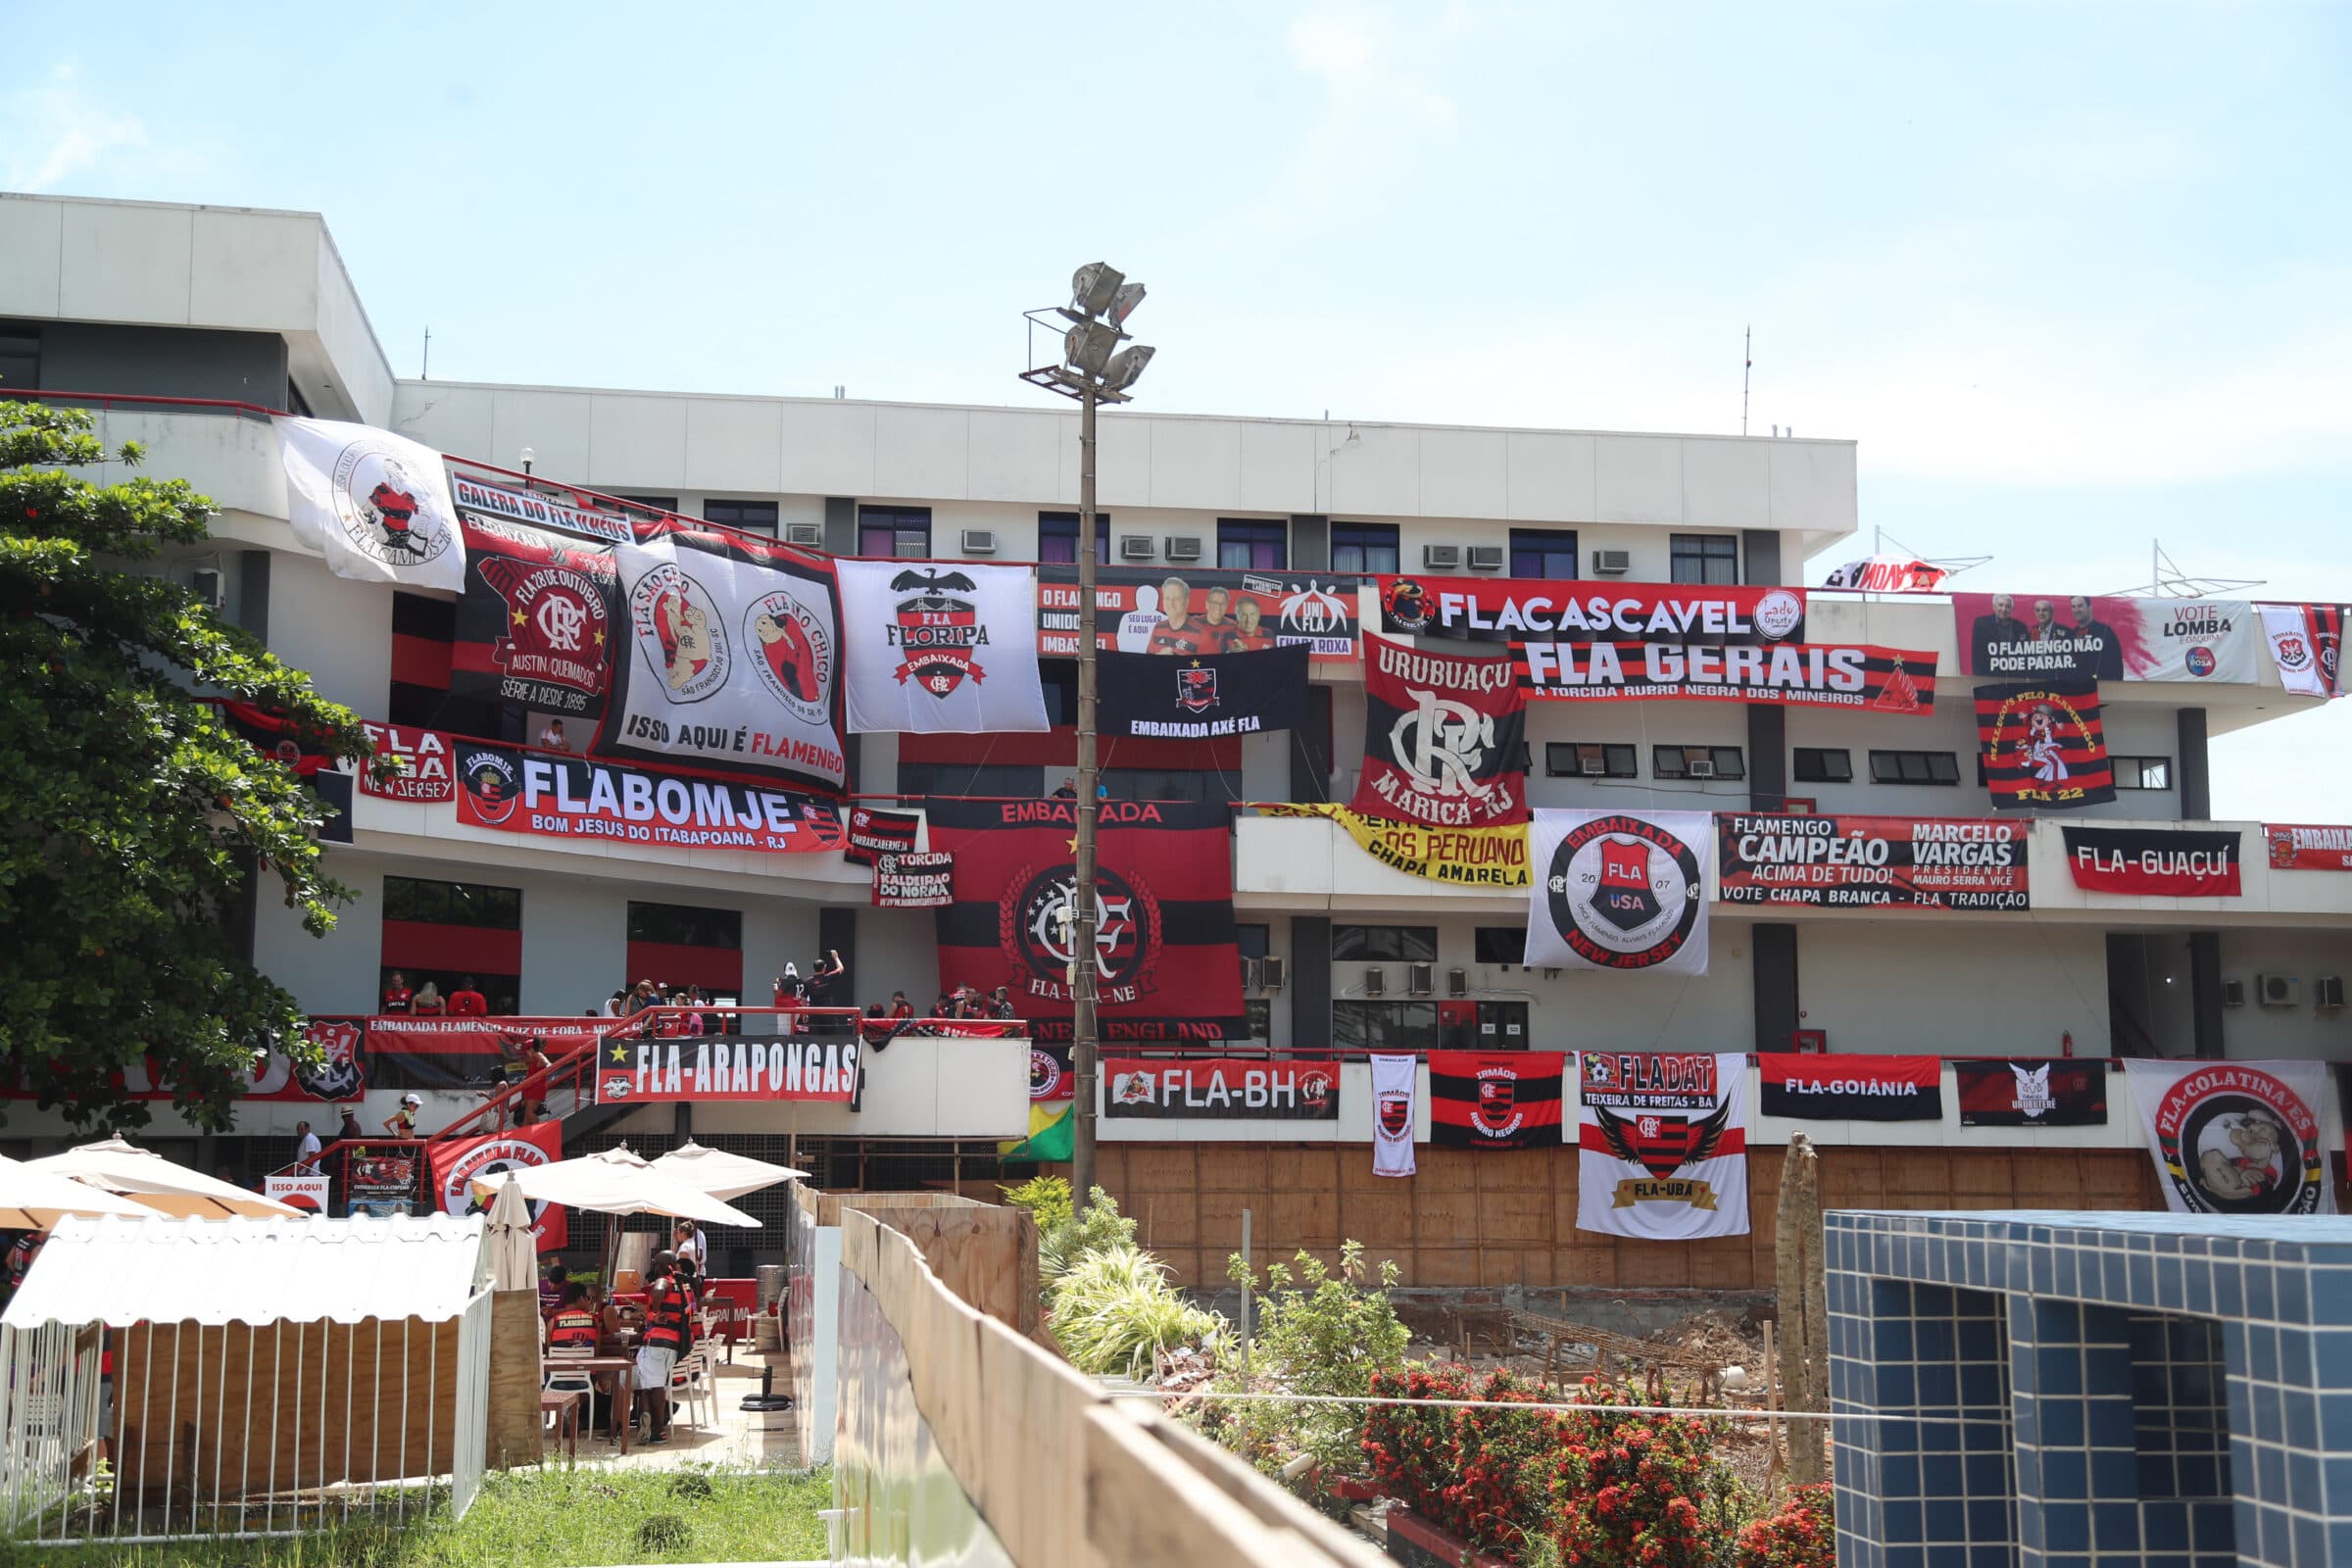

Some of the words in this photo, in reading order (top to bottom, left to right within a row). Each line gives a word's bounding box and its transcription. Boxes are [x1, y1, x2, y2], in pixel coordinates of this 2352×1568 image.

[458, 482, 521, 515] GALERA
[522, 499, 546, 521] DO
[550, 507, 576, 529] FLA
[515, 579, 538, 605] FLA
[531, 570, 547, 589] 28
[544, 568, 560, 586] DE
[559, 569, 605, 619] OUTUBRO
[1043, 589, 1053, 606] O
[1054, 589, 1121, 608] FLANGO
[923, 612, 952, 626] FLA
[1302, 601, 1324, 618] UNI
[1440, 592, 1751, 635] FLACASCAVEL
[2174, 605, 2218, 621] VOTE
[886, 623, 990, 647] FLORIPA
[1133, 625, 1149, 634] AQUI
[1302, 616, 1325, 633] FLA
[2164, 618, 2231, 637] LOMBA
[810, 629, 829, 684] CHICO
[1319, 639, 1349, 654] ROXA
[1987, 642, 1998, 657] O
[1999, 638, 2073, 656] FLAMENGO
[2074, 634, 2103, 654] NÃO
[907, 653, 969, 672] EMBAIXADA
[1378, 644, 1514, 695] URUBUAÇU
[1524, 642, 1626, 685] FLA
[1644, 641, 1866, 692] GERAIS
[1990, 656, 2026, 671] PODE
[2027, 654, 2077, 670] PARAR.
[501, 678, 529, 700] SÉRIE
[529, 685, 536, 703] A
[538, 686, 564, 708] DESDE
[564, 694, 588, 711] 1895
[1535, 686, 1545, 697] A
[1551, 686, 1618, 698] TORCIDA
[1624, 684, 1679, 697] RUBRO
[1685, 685, 1740, 699] NEGRA
[1746, 687, 1780, 700] DOS
[1786, 689, 1865, 706] MINEIROS
[1131, 720, 1209, 738] EMBAIXADA
[1210, 715, 1236, 736] AXÉ
[1238, 715, 1261, 733] FLA
[2017, 690, 2045, 703] PELO
[2047, 693, 2096, 754] FLAMENGO
[363, 723, 446, 755] FLA
[627, 712, 669, 744] ISSO
[678, 724, 728, 752] AQUI
[733, 724, 748, 753] É
[751, 730, 845, 775] FLAMENGO
[466, 751, 514, 778] FLABOMJE
[396, 779, 454, 799] JERSEY
[522, 759, 798, 834] FLABOMJE
[2017, 788, 2051, 802] FLA
[2058, 787, 2084, 801] 22
[1001, 802, 1162, 824] EMBAADA
[532, 814, 569, 834] BOM
[574, 815, 625, 838] JESUS
[628, 825, 651, 842] DO
[655, 826, 756, 848] ITABAPOANA
[766, 835, 786, 850] RJ
[1566, 816, 1688, 859] EMBAIXADA
[1734, 817, 1832, 836] FLAMENGO
[1911, 823, 2012, 844] MARCELO
[1427, 832, 1525, 866] PERUANO
[1739, 829, 1889, 866] CAMPEÃO
[1911, 842, 2012, 866] VARGAS
[899, 853, 953, 866] TORCIDA
[1368, 838, 1428, 877] CHAPA
[1438, 863, 1529, 886] AMARELA
[1912, 865, 2013, 875] PRESIDENTE
[2077, 845, 2230, 881] FLA-GUAÇUÍ
[1581, 872, 1596, 884] 20
[1655, 879, 1671, 890] 07
[1607, 862, 1642, 881] FLA
[1751, 864, 1806, 882] ACIMA
[1812, 866, 1834, 883] DE
[1838, 867, 1894, 885] TUDO!
[1912, 875, 1951, 886] MAURO
[1952, 876, 1985, 887] SERRA
[1989, 875, 2013, 887] VICE
[880, 884, 900, 896] DO
[902, 884, 950, 898] NORMA
[1609, 893, 1645, 911] USA
[1723, 886, 1764, 902] VOTE
[1770, 888, 1821, 904] CHAPA
[1828, 889, 1891, 905] BRANCA
[1913, 892, 1940, 906] FLA
[1949, 889, 2027, 910] TRADIÇÃO
[1564, 928, 1612, 964] NEW
[1610, 930, 1684, 969] JERSEY
[370, 1020, 437, 1033] EMBAIXADA
[441, 1021, 501, 1034] FLAMENGO
[506, 1024, 529, 1035] JUIZ
[533, 1026, 549, 1035] DE
[552, 1025, 583, 1035] FORA
[1106, 1021, 1223, 1041] ENGLAND
[635, 1042, 856, 1094] FLA-ARAPONGAS
[1476, 1066, 1517, 1081] IRMÃOS
[1618, 1054, 1713, 1092] FLADAT
[1162, 1069, 1296, 1108] FLA-BH
[1786, 1078, 1918, 1097] FLA-GOIÂNIA
[1585, 1093, 1630, 1106] TEIXEIRA
[1634, 1095, 1646, 1106] DE
[1649, 1096, 1689, 1107] FREITAS
[1698, 1096, 1713, 1108] BA
[1470, 1111, 1494, 1138] RUBRO
[1494, 1112, 1524, 1139] NEGROS
[272, 1183, 293, 1192] ISSO
[296, 1183, 322, 1192] AQUI
[1634, 1179, 1693, 1198] FLA-UBÁ
